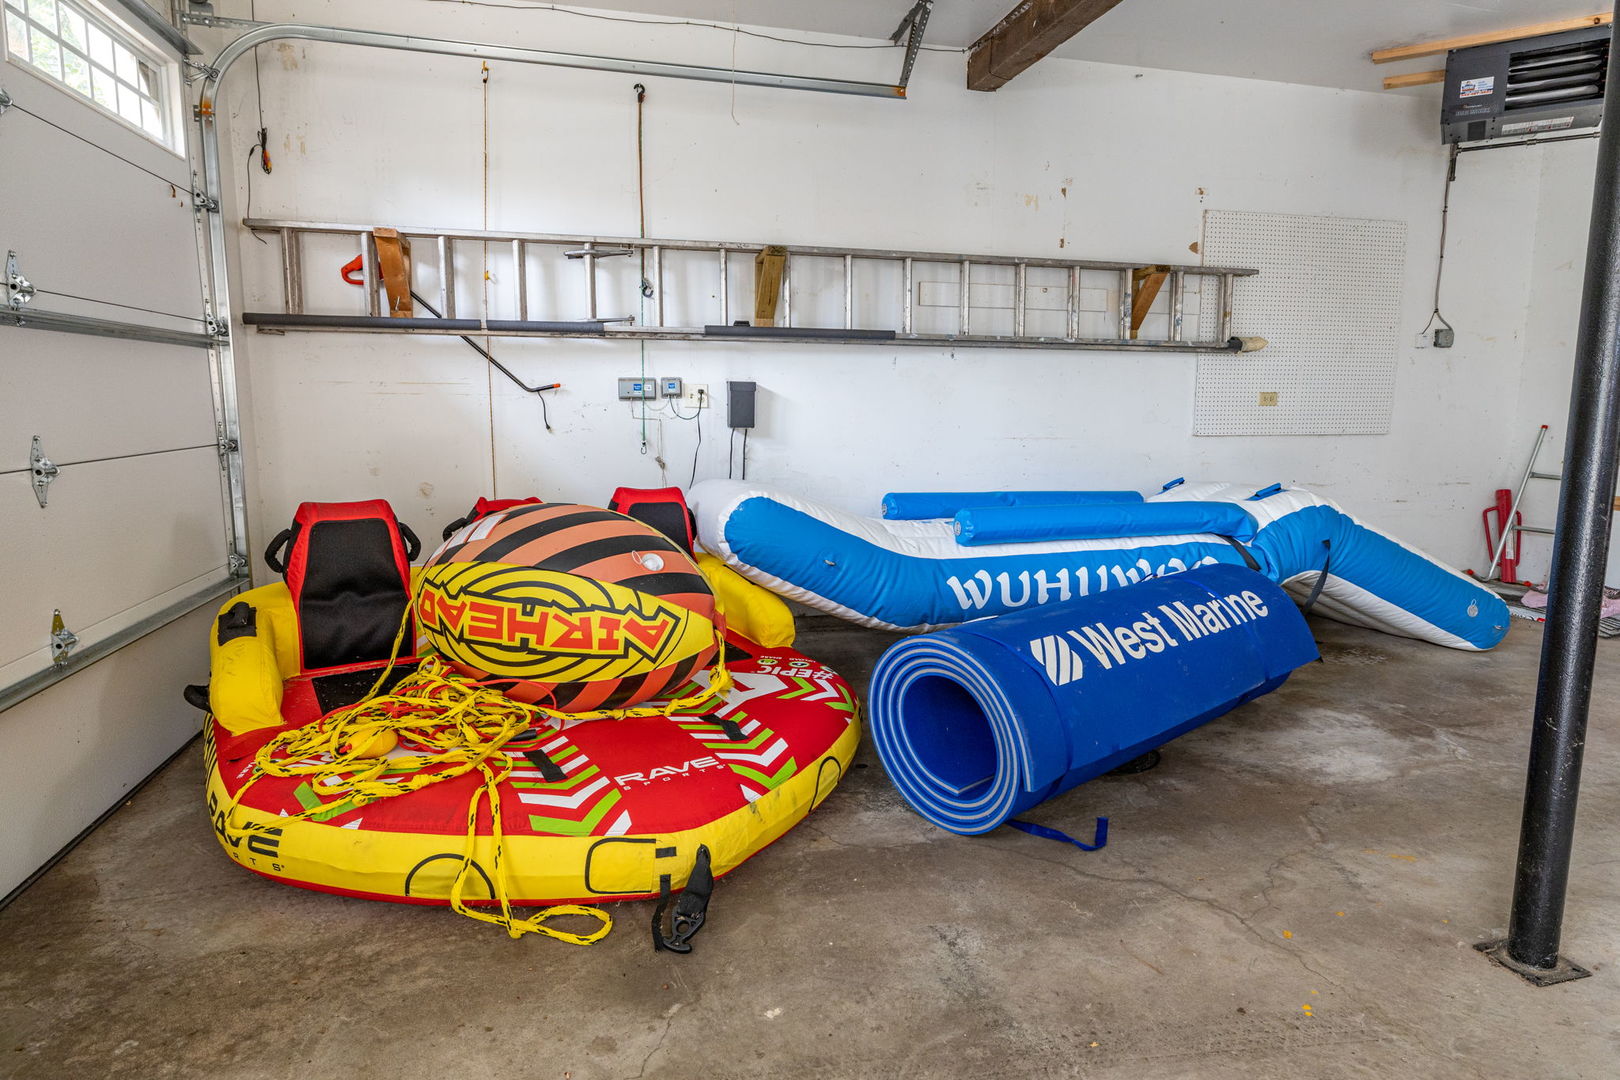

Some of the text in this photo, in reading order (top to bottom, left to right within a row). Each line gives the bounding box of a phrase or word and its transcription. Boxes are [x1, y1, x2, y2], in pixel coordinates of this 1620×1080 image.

[419, 587, 670, 651] AIRHEAD
[1067, 589, 1269, 670] West Marine
[613, 756, 720, 786] RAVE
[623, 764, 723, 791] SPORTS
